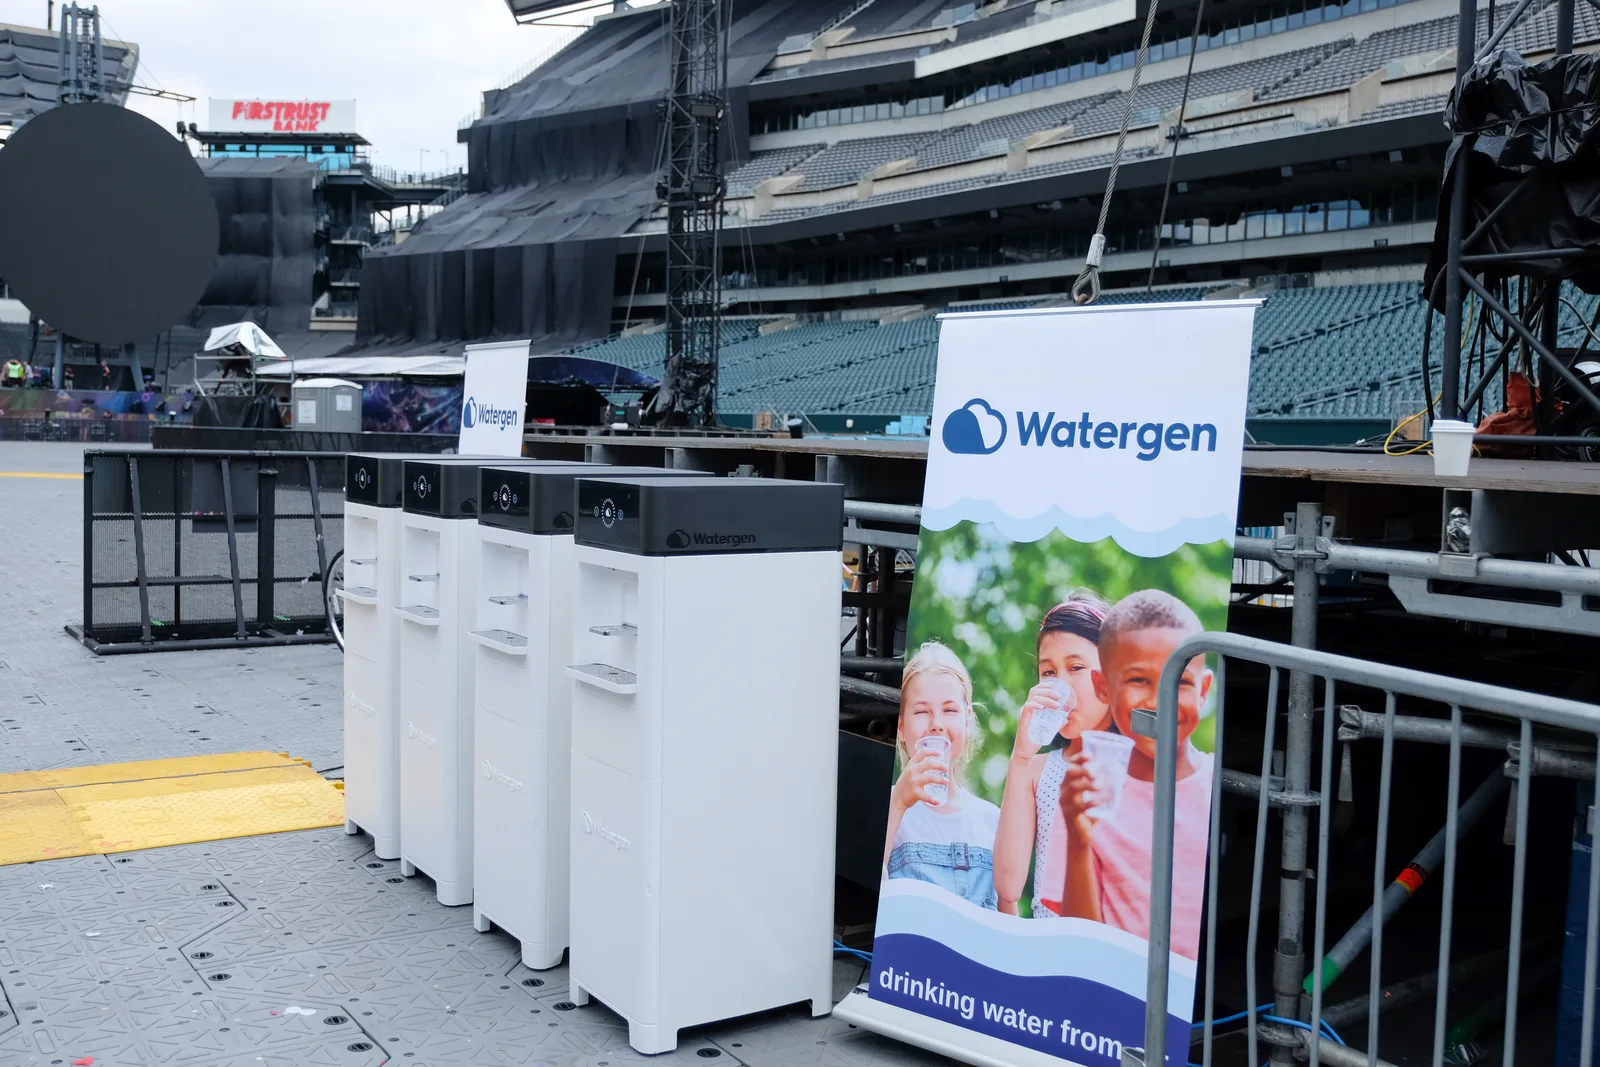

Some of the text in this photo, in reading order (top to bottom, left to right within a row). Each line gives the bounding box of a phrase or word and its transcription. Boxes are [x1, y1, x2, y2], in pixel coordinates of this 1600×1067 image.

[273, 120, 319, 131] BANK
[479, 404, 518, 431] Watergen
[1016, 411, 1218, 461] Watergen
[692, 532, 756, 547] Watergen
[879, 966, 975, 1020] drinking
[982, 1000, 1053, 1037] water
[1060, 1019, 1122, 1059] from
